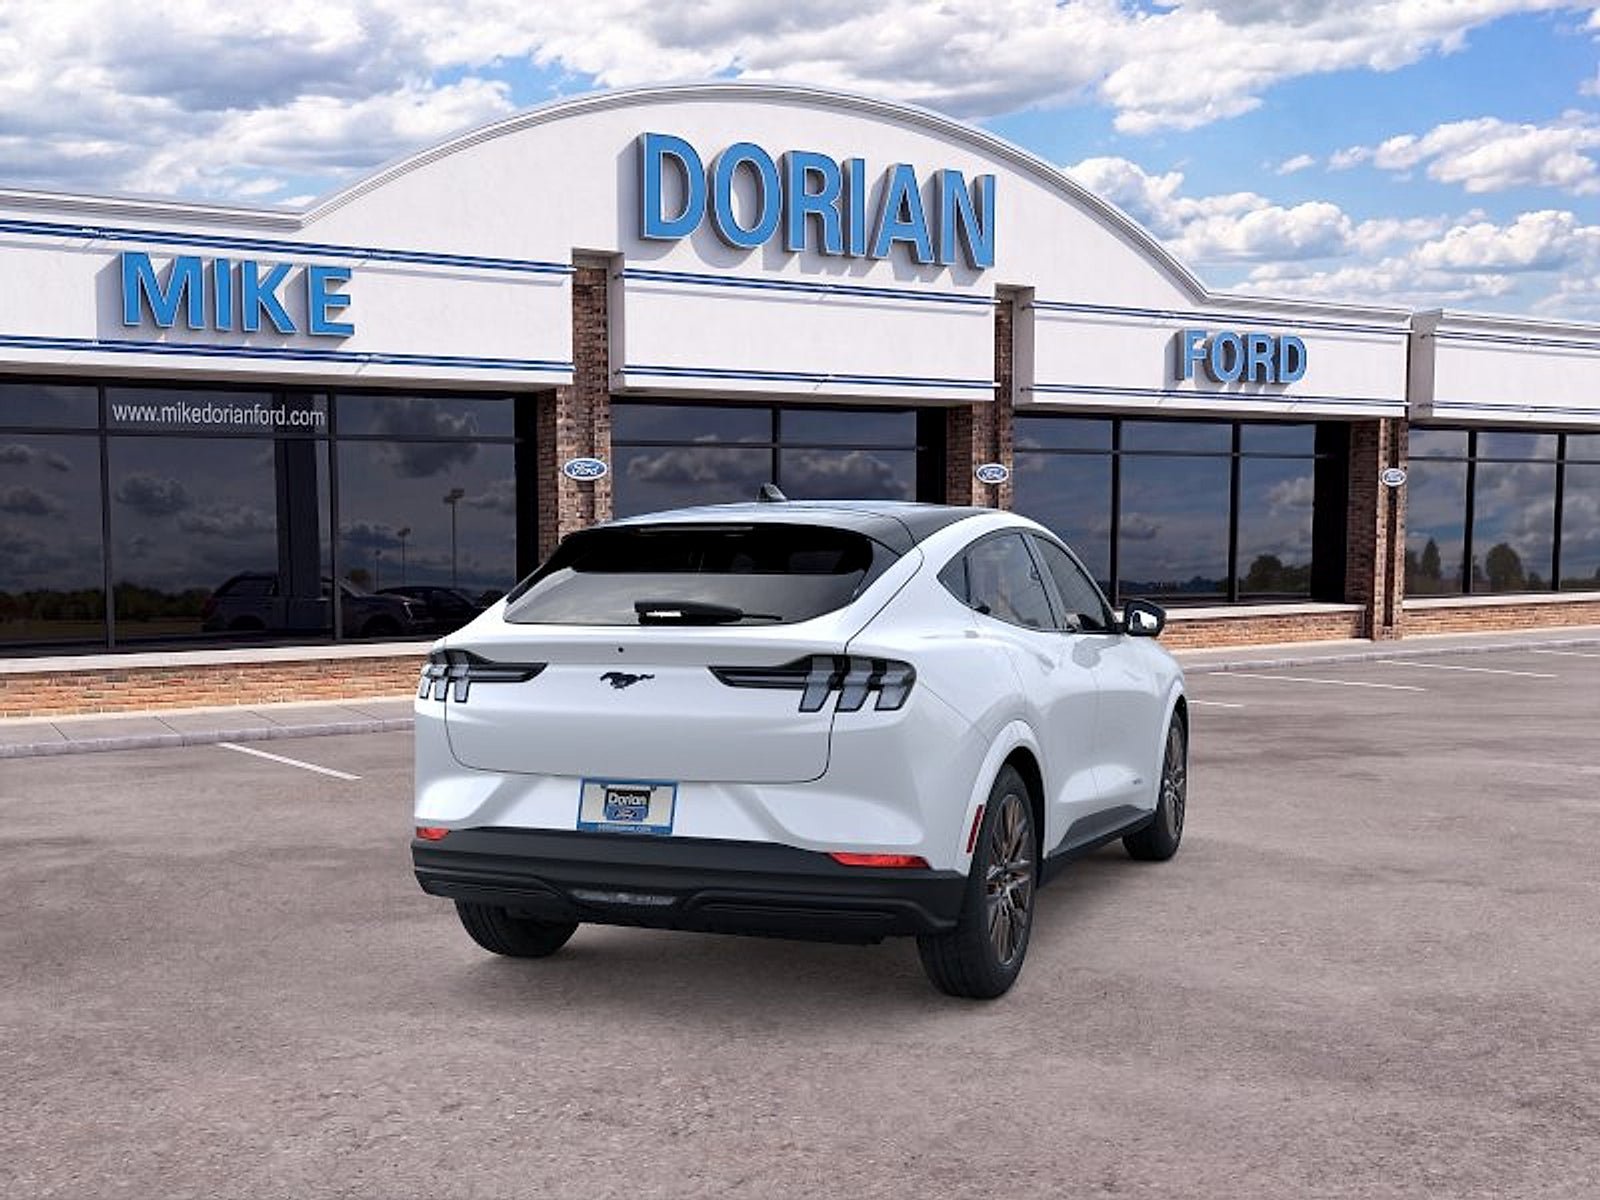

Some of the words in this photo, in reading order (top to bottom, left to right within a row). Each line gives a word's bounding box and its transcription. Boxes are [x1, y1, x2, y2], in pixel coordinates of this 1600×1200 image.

[641, 132, 995, 268] DORIAN
[121, 252, 355, 337] MIKE
[1182, 329, 1307, 383] FORD
[111, 402, 325, 426] www.mikedorianford.com
[608, 791, 646, 806] Dorian
